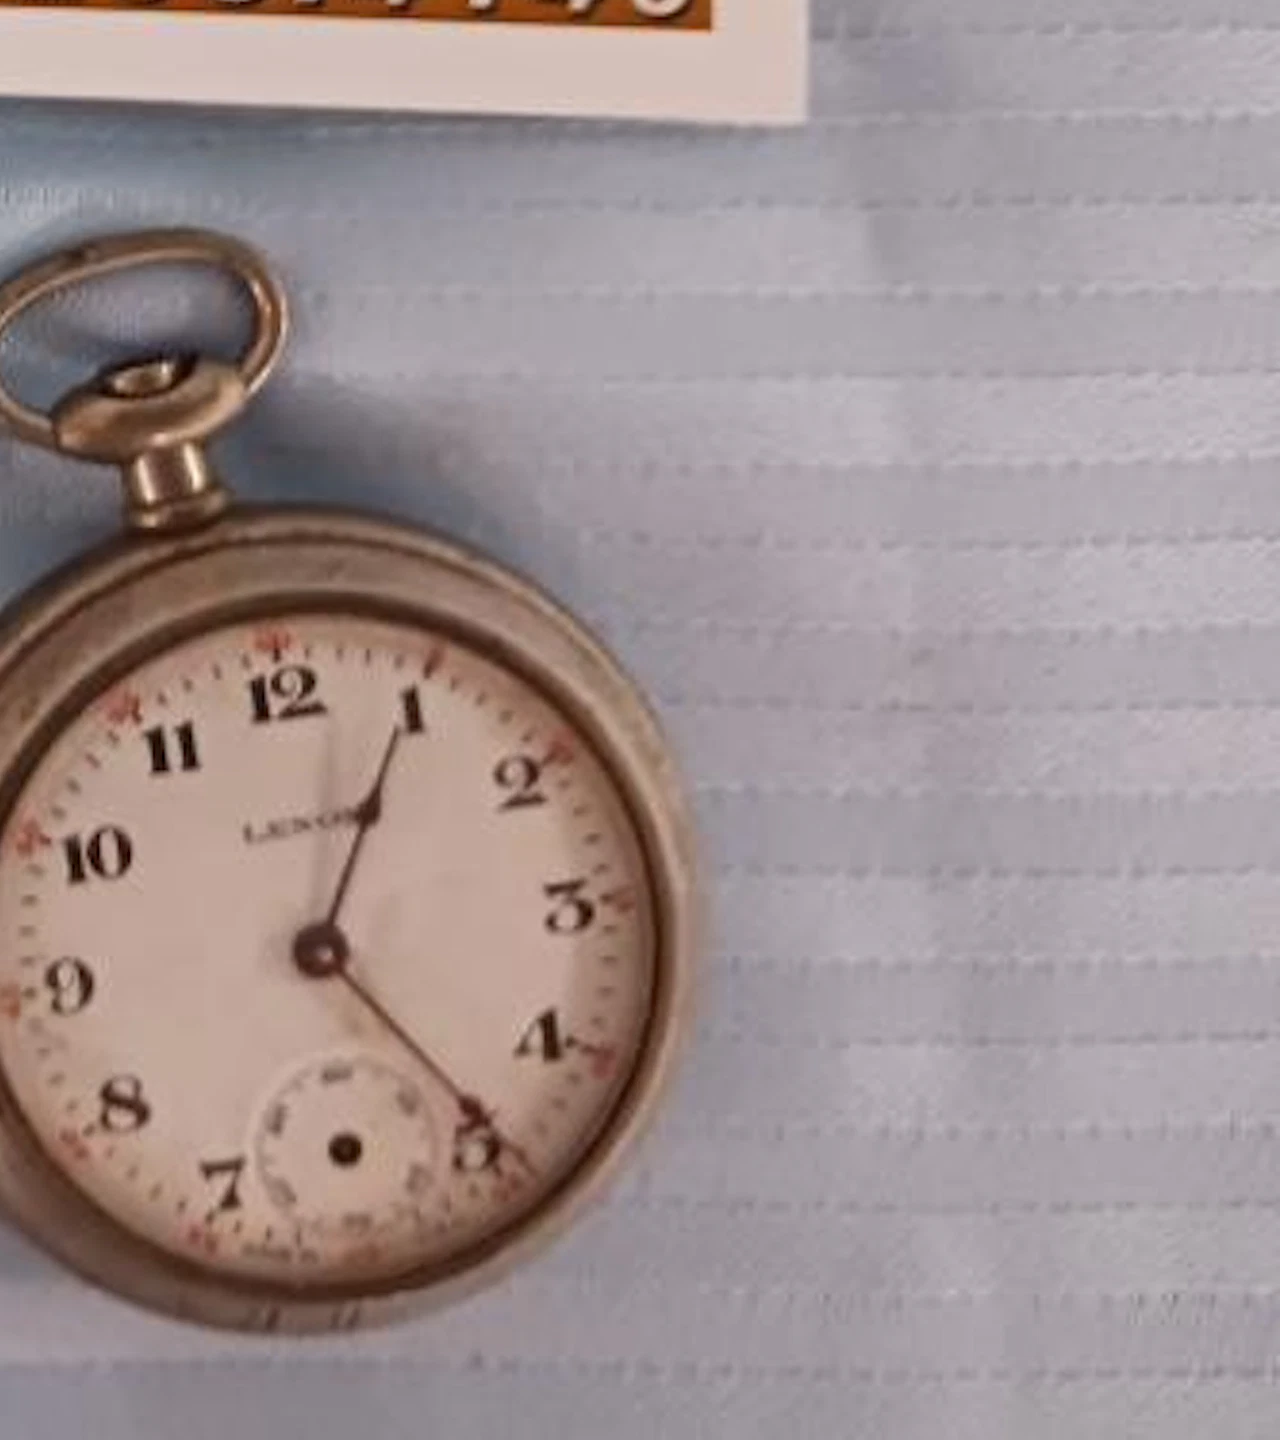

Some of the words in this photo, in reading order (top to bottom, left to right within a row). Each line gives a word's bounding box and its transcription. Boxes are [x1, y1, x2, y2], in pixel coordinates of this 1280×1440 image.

[248, 666, 328, 725] 12
[396, 686, 426, 735] 1
[141, 722, 202, 777] 11
[493, 756, 547, 811] 2
[63, 826, 133, 883] 10
[543, 879, 595, 937] 3
[45, 958, 95, 1015] 9
[513, 1009, 566, 1062] 4
[99, 1074, 151, 1134] 8
[200, 1157, 245, 1211] 7
